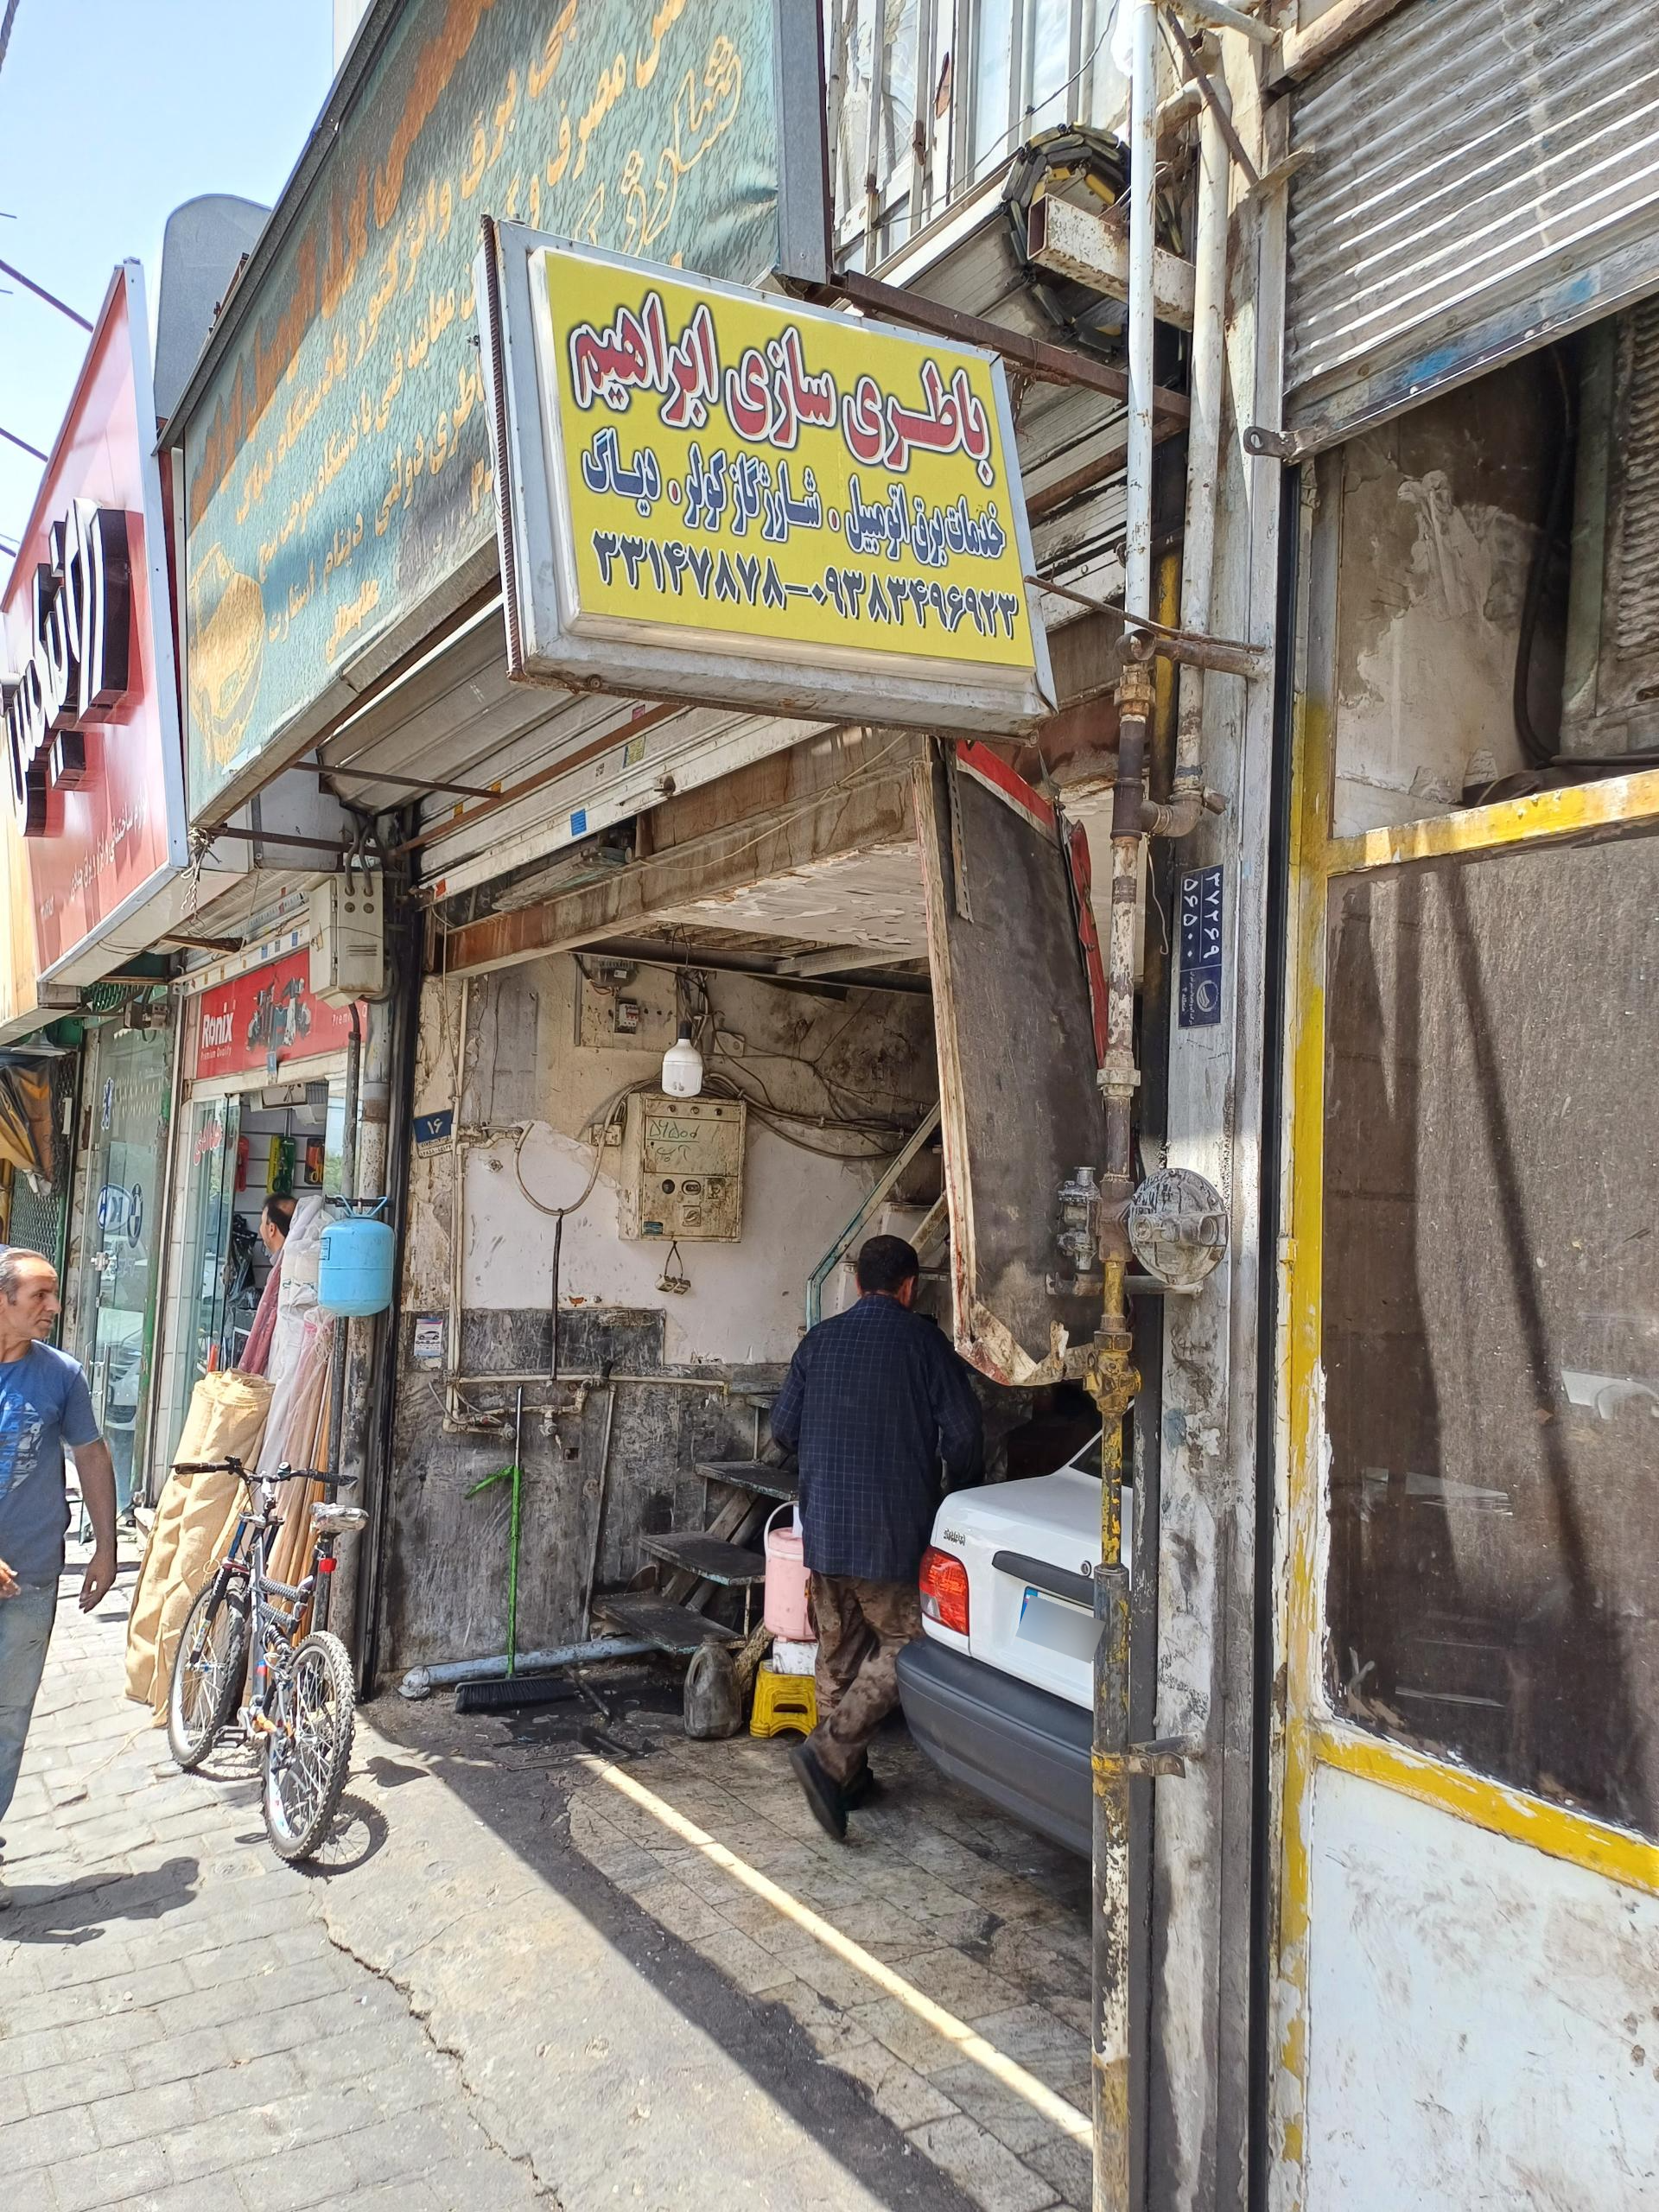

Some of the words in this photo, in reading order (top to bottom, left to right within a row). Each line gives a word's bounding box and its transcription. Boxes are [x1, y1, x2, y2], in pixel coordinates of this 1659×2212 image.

[459, 70, 517, 200] برق
[546, 54, 626, 187] مصرف
[620, 35, 743, 257] شارژ
[375, 338, 404, 433] فنی
[569, 292, 721, 429] ابراهیم
[726, 327, 836, 448] سازی
[430, 352, 484, 474] اطری
[844, 360, 994, 486] باطری
[377, 430, 425, 535] دولتی
[582, 427, 662, 517] دیاگ
[684, 443, 728, 531] کولر
[728, 449, 766, 537] گاز
[757, 459, 822, 543] شارژ
[326, 512, 364, 595] دینام
[844, 476, 911, 562] اتومبیل
[906, 492, 949, 568] برق
[944, 497, 1007, 560] خدمات
[270, 560, 315, 642] استارت
[6, 498, 117, 836] رونیکس
[1183, 878, 1199, 958] ۵۶۵۰۰
[1203, 873, 1220, 959] ۳۷۲۶۹
[201, 1002, 234, 1049] Ronix
[427, 1118, 442, 1135] ۱۶
